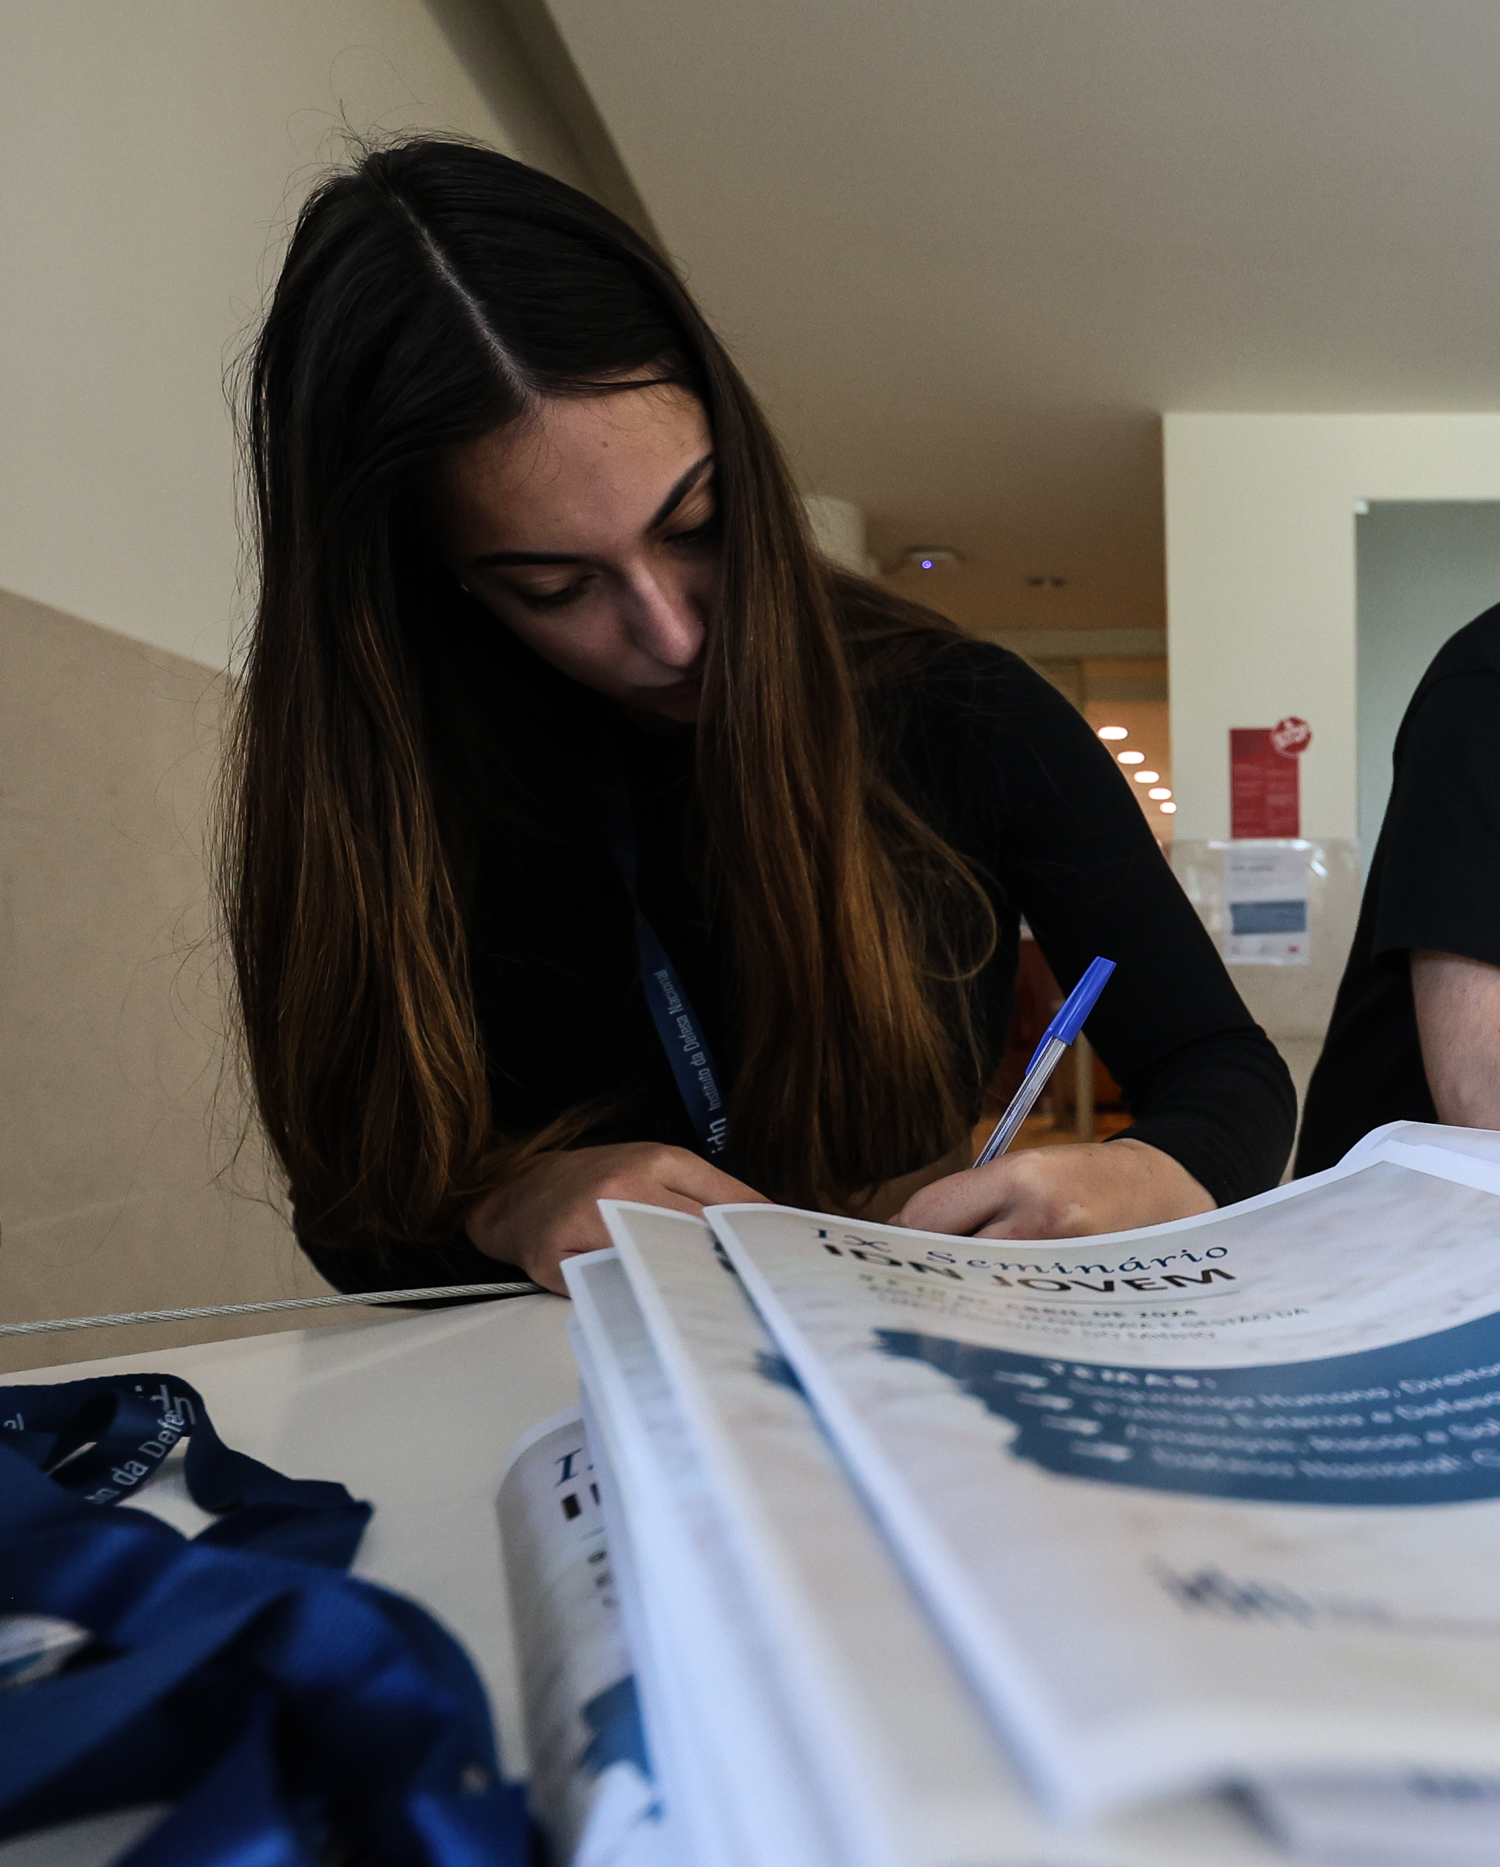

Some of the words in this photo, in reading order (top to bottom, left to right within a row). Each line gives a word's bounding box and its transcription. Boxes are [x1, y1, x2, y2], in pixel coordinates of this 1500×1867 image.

[653, 968, 684, 1015] Nacional
[676, 1014, 700, 1052] Defesa
[690, 1051, 706, 1066] da
[698, 1068, 722, 1112] Instituto
[811, 1227, 892, 1253] IX
[926, 1246, 1228, 1275] Seminário
[991, 1268, 1237, 1293] JOVEM
[1370, 1410, 1394, 1425] e
[111, 1459, 150, 1487] da
